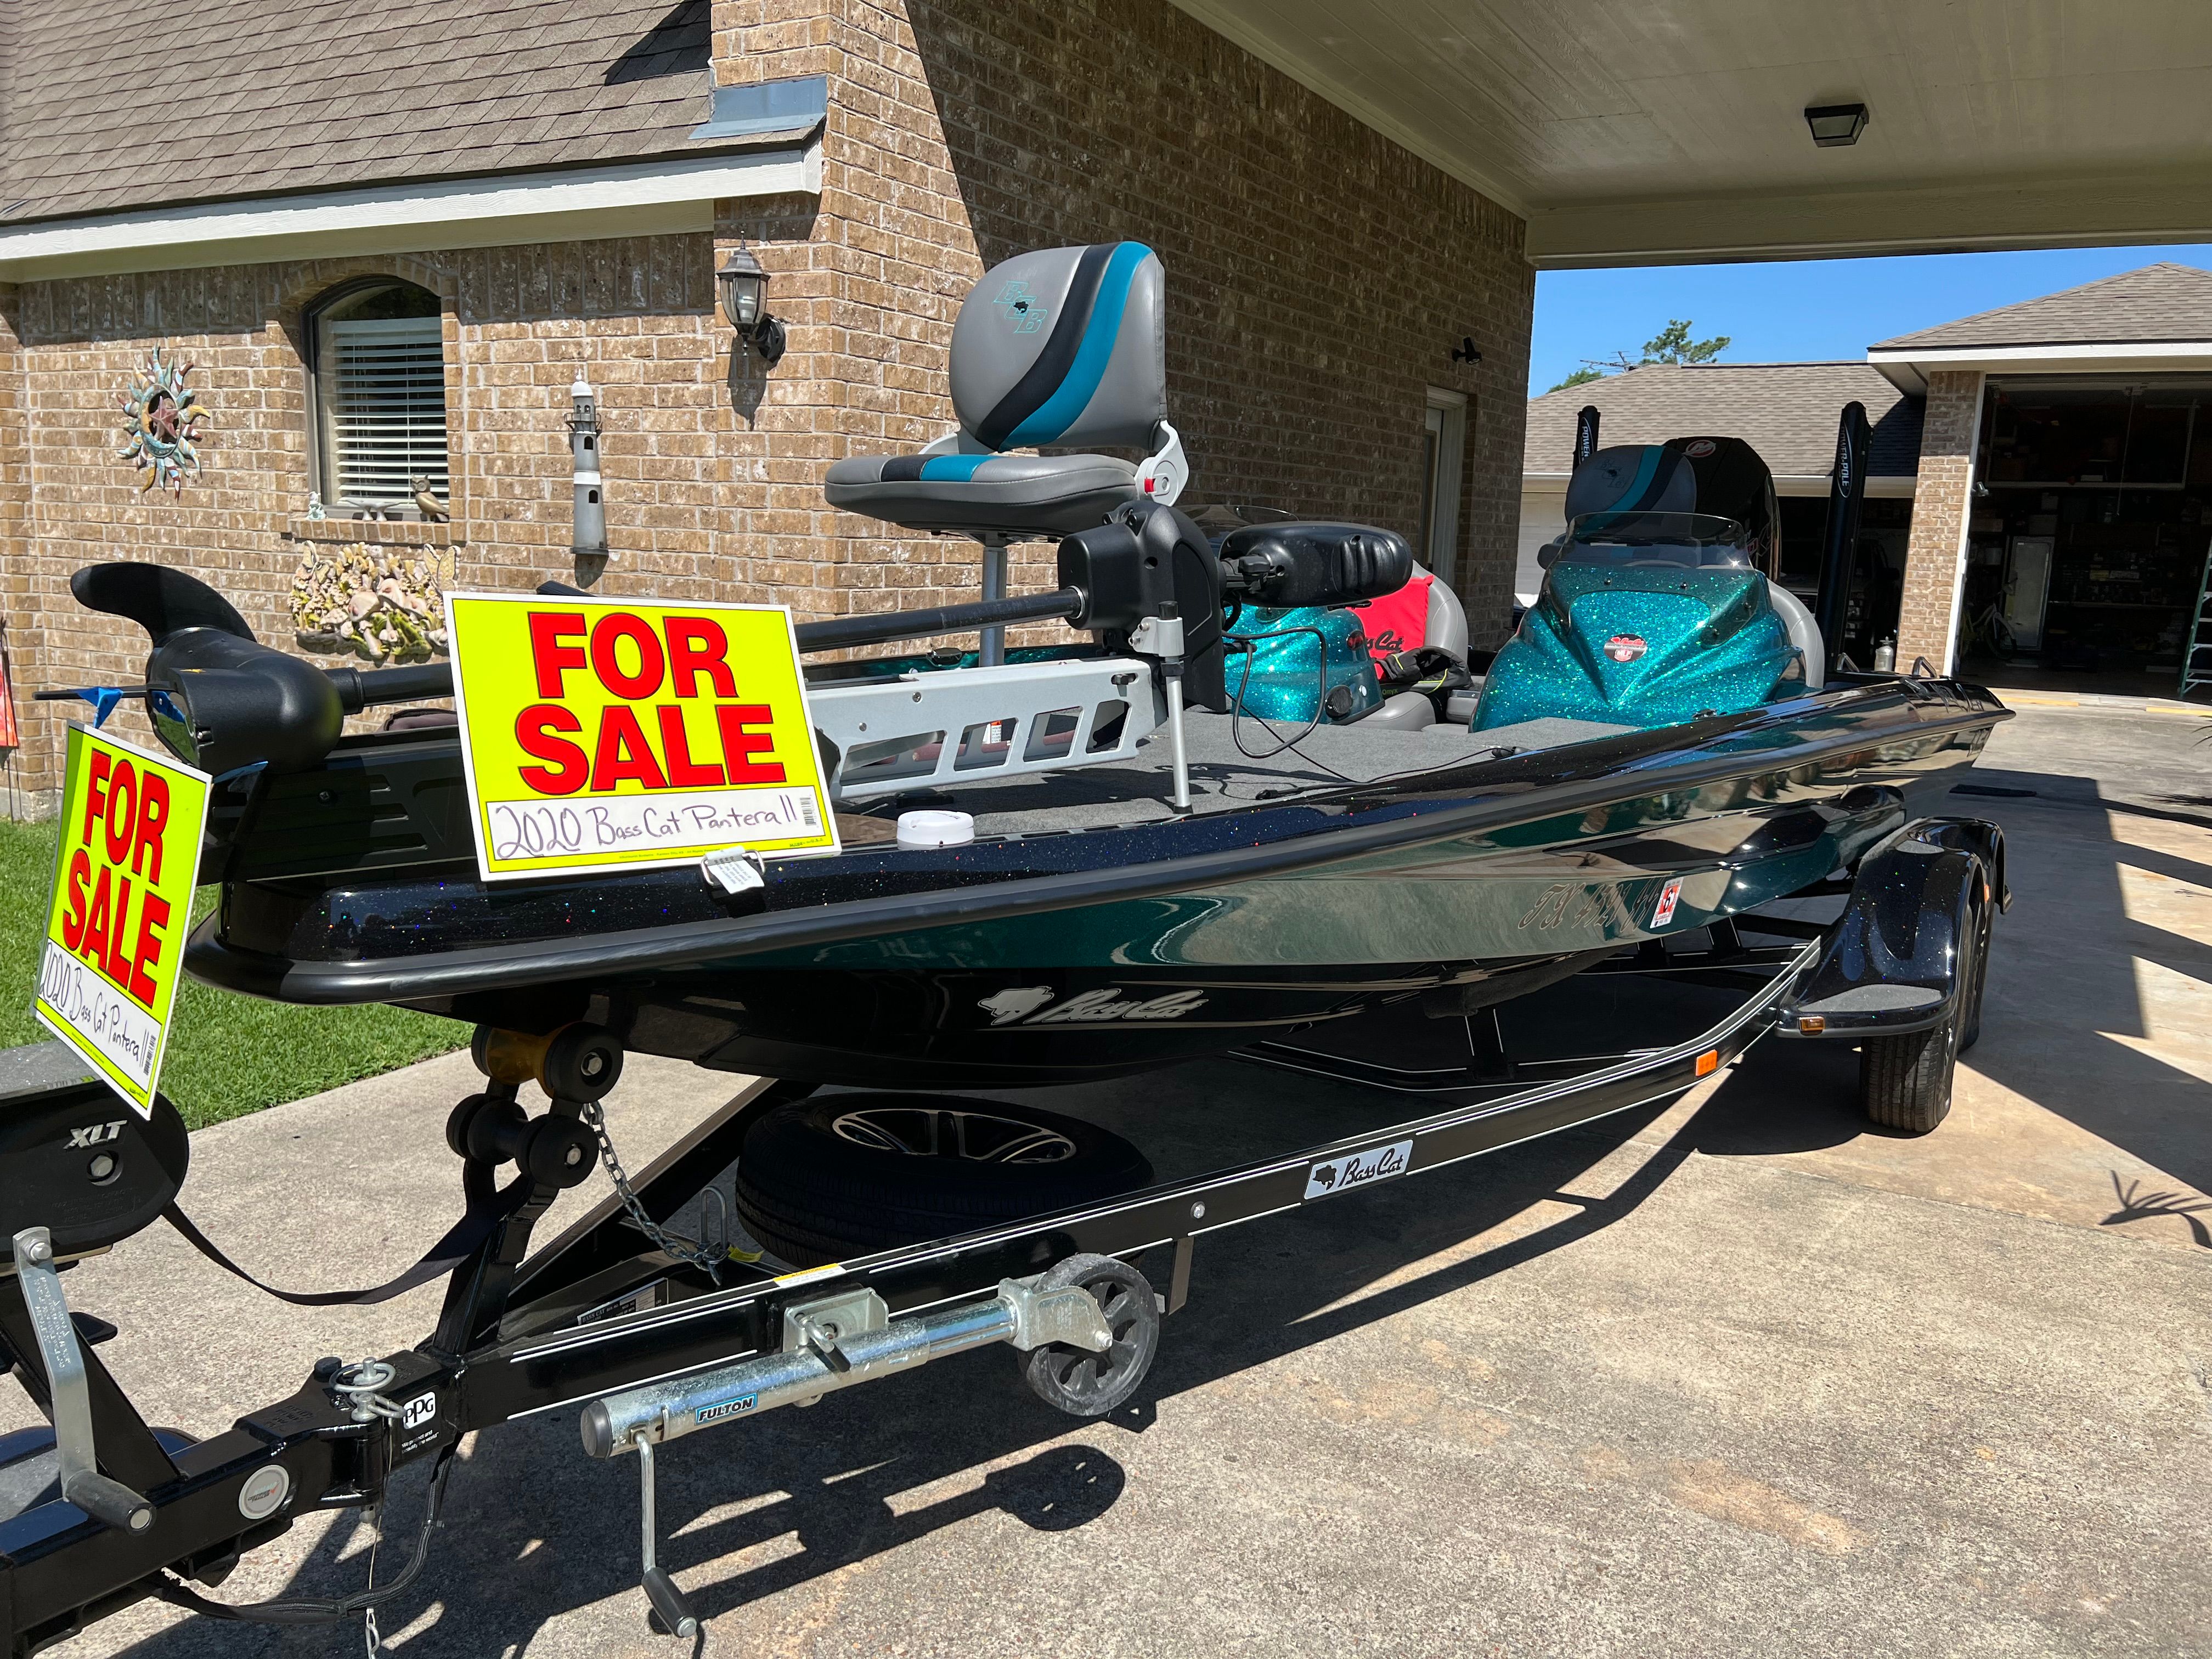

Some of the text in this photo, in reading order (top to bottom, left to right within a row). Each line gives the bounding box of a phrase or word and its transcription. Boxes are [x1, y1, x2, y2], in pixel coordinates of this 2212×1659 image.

[527, 611, 739, 700] FOR
[515, 704, 787, 795] SALE
[83, 747, 170, 887] FOR
[495, 805, 582, 859] 2020
[585, 806, 642, 846] Bass
[644, 807, 682, 838] Cat
[681, 804, 782, 831] Pantera
[63, 848, 171, 1008] SALE
[40, 943, 71, 1012] 2020
[70, 967, 91, 1023] Bass
[94, 992, 108, 1034] Cat
[109, 1005, 140, 1061] Pantera
[63, 1120, 127, 1149] XLT
[405, 1397, 433, 1424] PPG
[698, 1396, 754, 1422] FULTON
